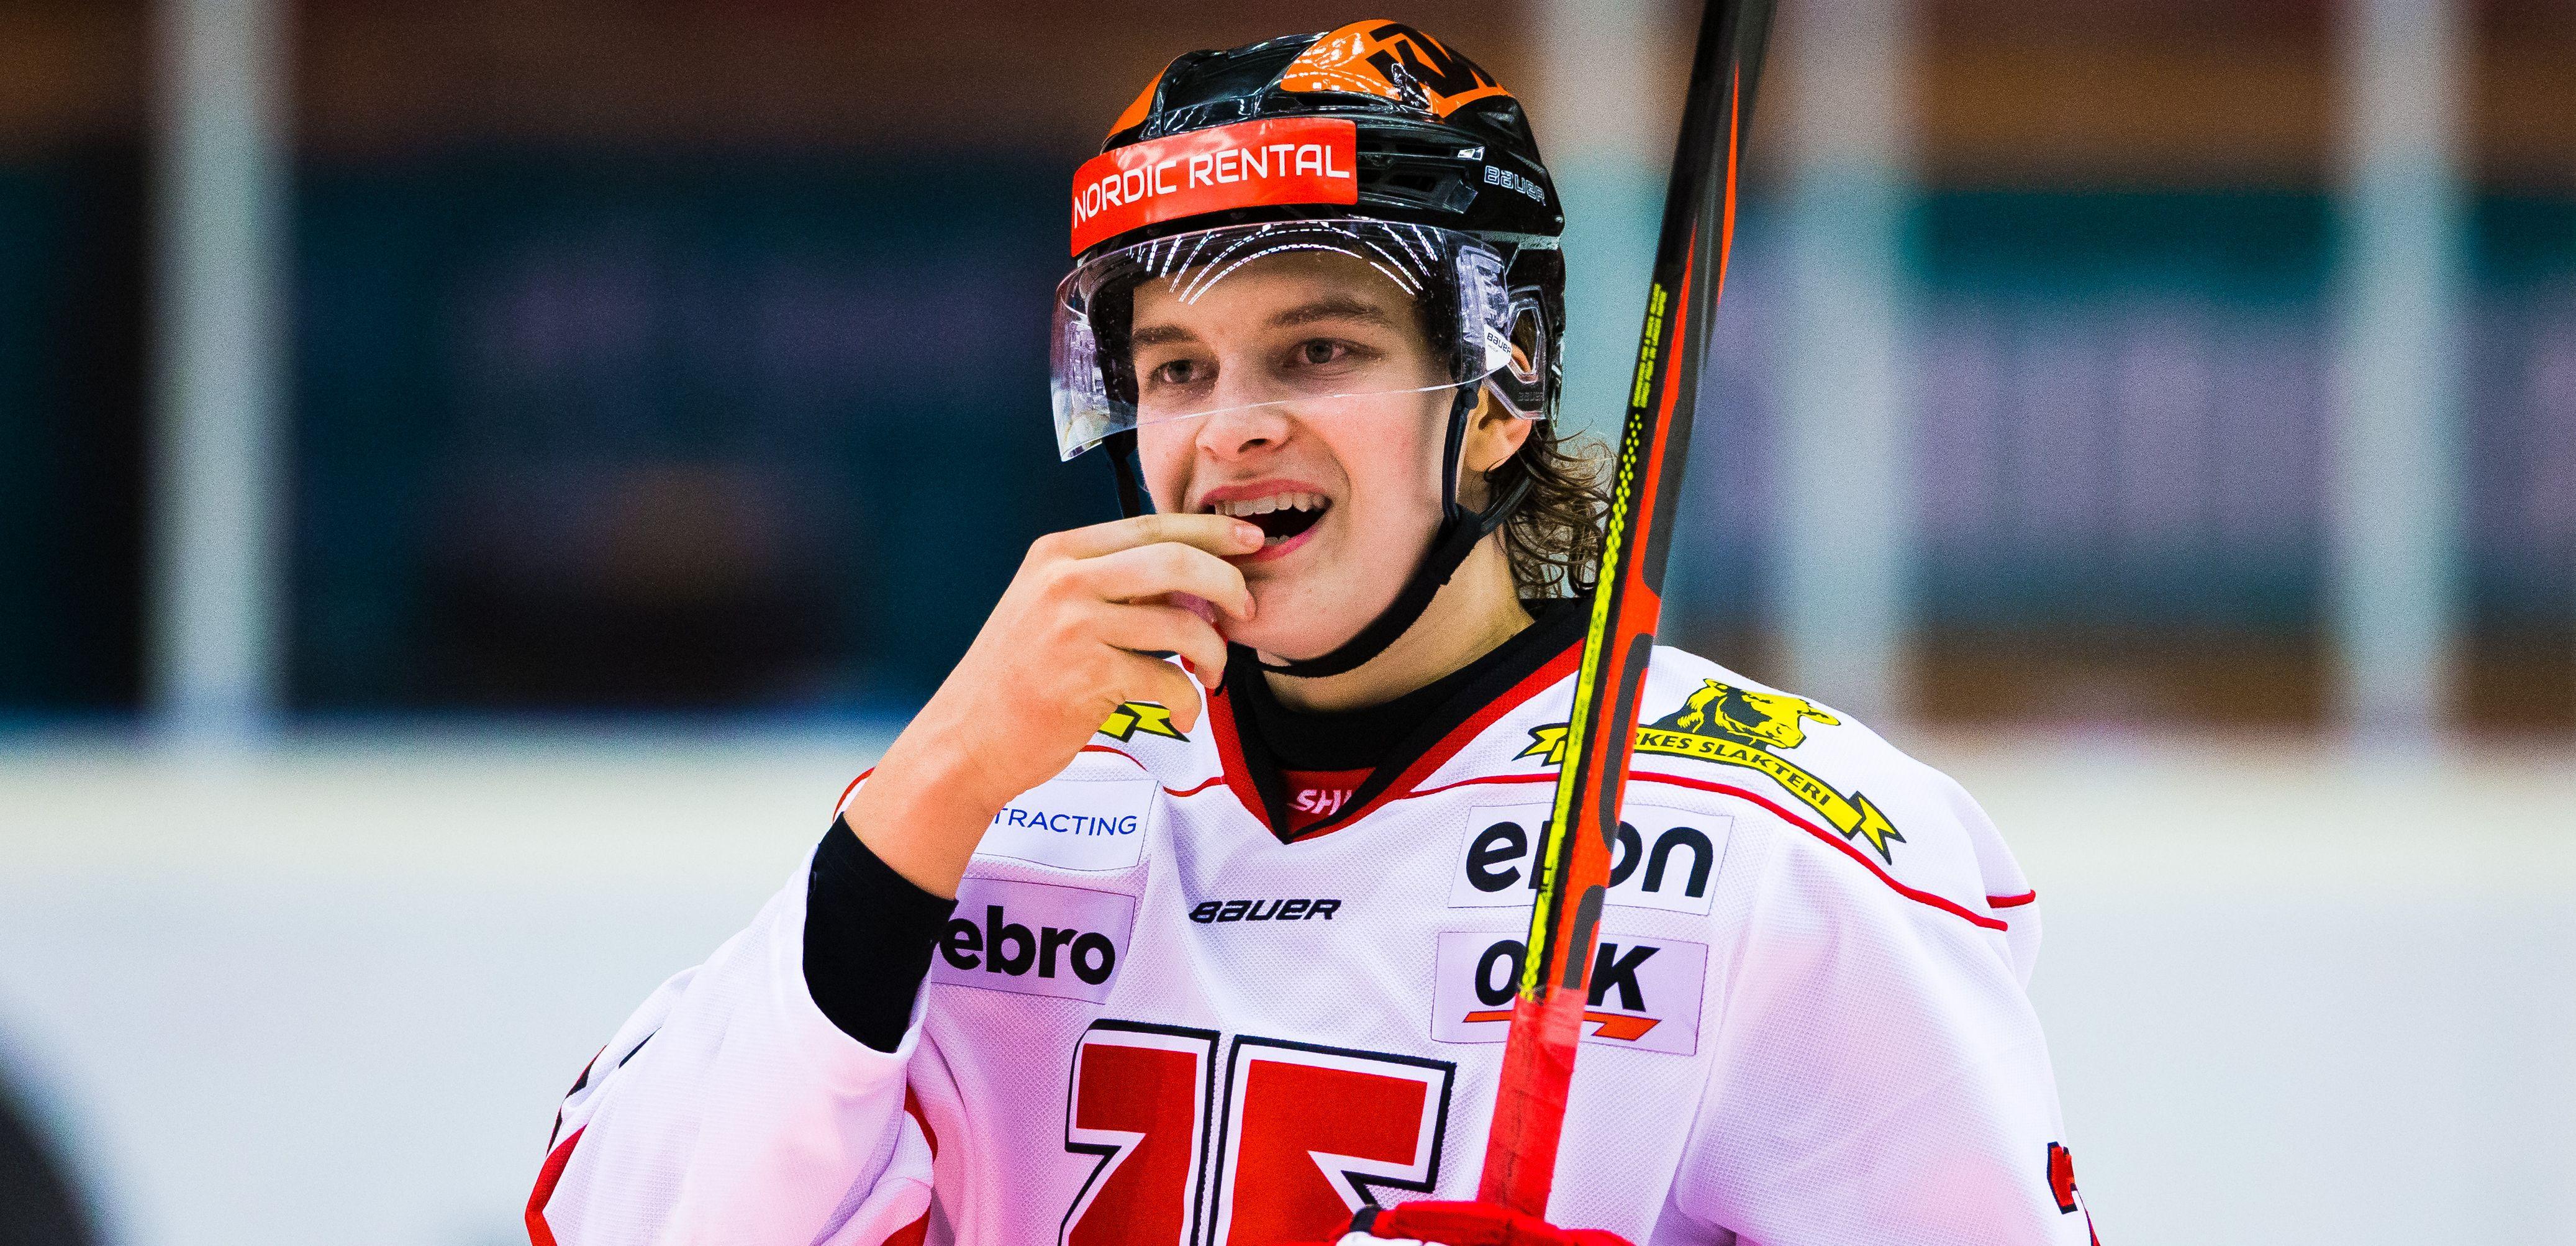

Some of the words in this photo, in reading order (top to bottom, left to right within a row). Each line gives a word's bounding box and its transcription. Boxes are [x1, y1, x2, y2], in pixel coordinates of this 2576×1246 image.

[1073, 160, 1177, 229] NORDIC
[1189, 143, 1350, 189] RENTAL
[1699, 741, 1831, 806] SLAKTERI
[1475, 939, 1661, 1012] OK
